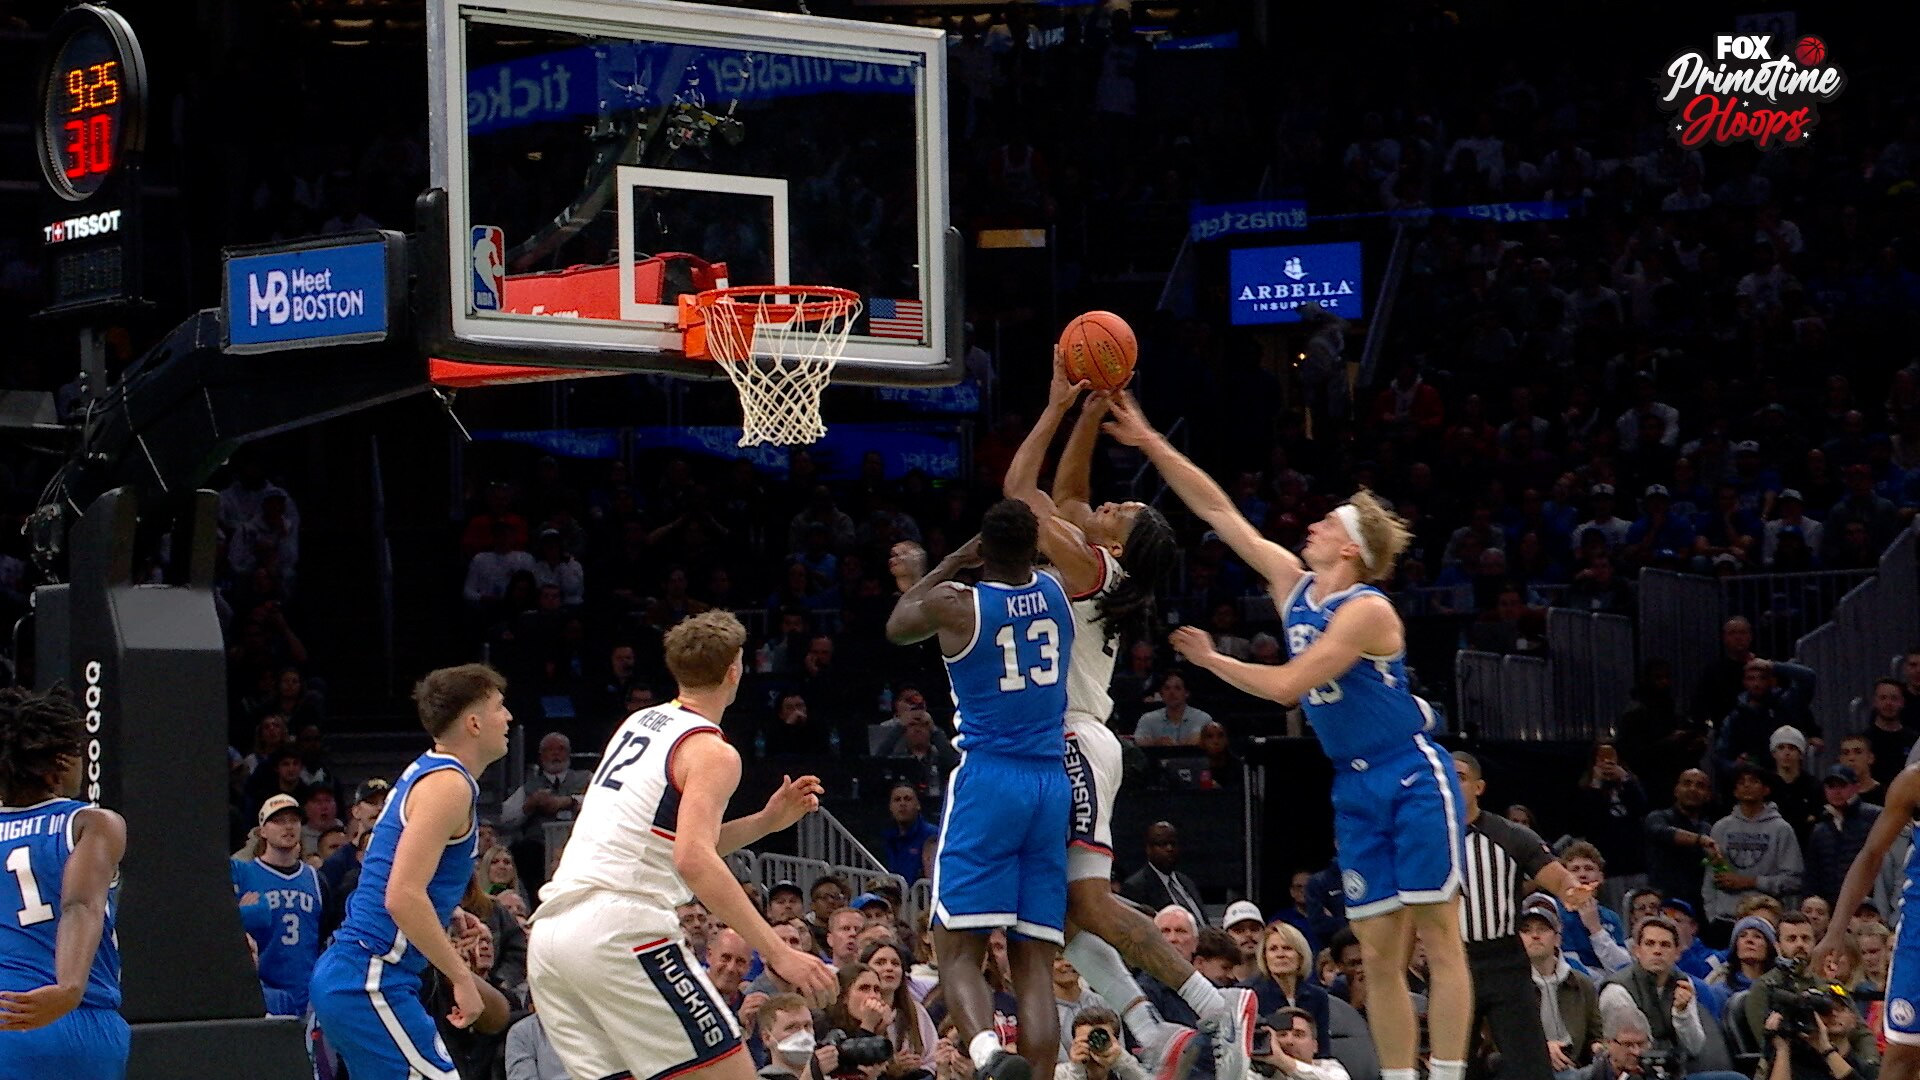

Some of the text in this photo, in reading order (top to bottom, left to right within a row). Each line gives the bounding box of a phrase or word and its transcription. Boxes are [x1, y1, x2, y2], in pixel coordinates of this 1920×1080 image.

[68, 61, 118, 113] 9:25
[64, 113, 113, 179] 30
[64, 209, 122, 240] TISSOT
[292, 267, 332, 294] Meet
[1238, 280, 1353, 300] ARBELLA
[293, 289, 364, 323] BOSTON
[1253, 299, 1338, 312] INSURCE
[1006, 591, 1048, 618] KEITA
[996, 618, 1060, 692] 13
[85, 660, 101, 734] QQQ
[637, 709, 675, 733] REIBE
[594, 730, 651, 791] 12
[5, 845, 54, 927] 1
[265, 889, 314, 923] BYU
[281, 913, 300, 945] 3
[655, 948, 724, 1048] HUSKIES
